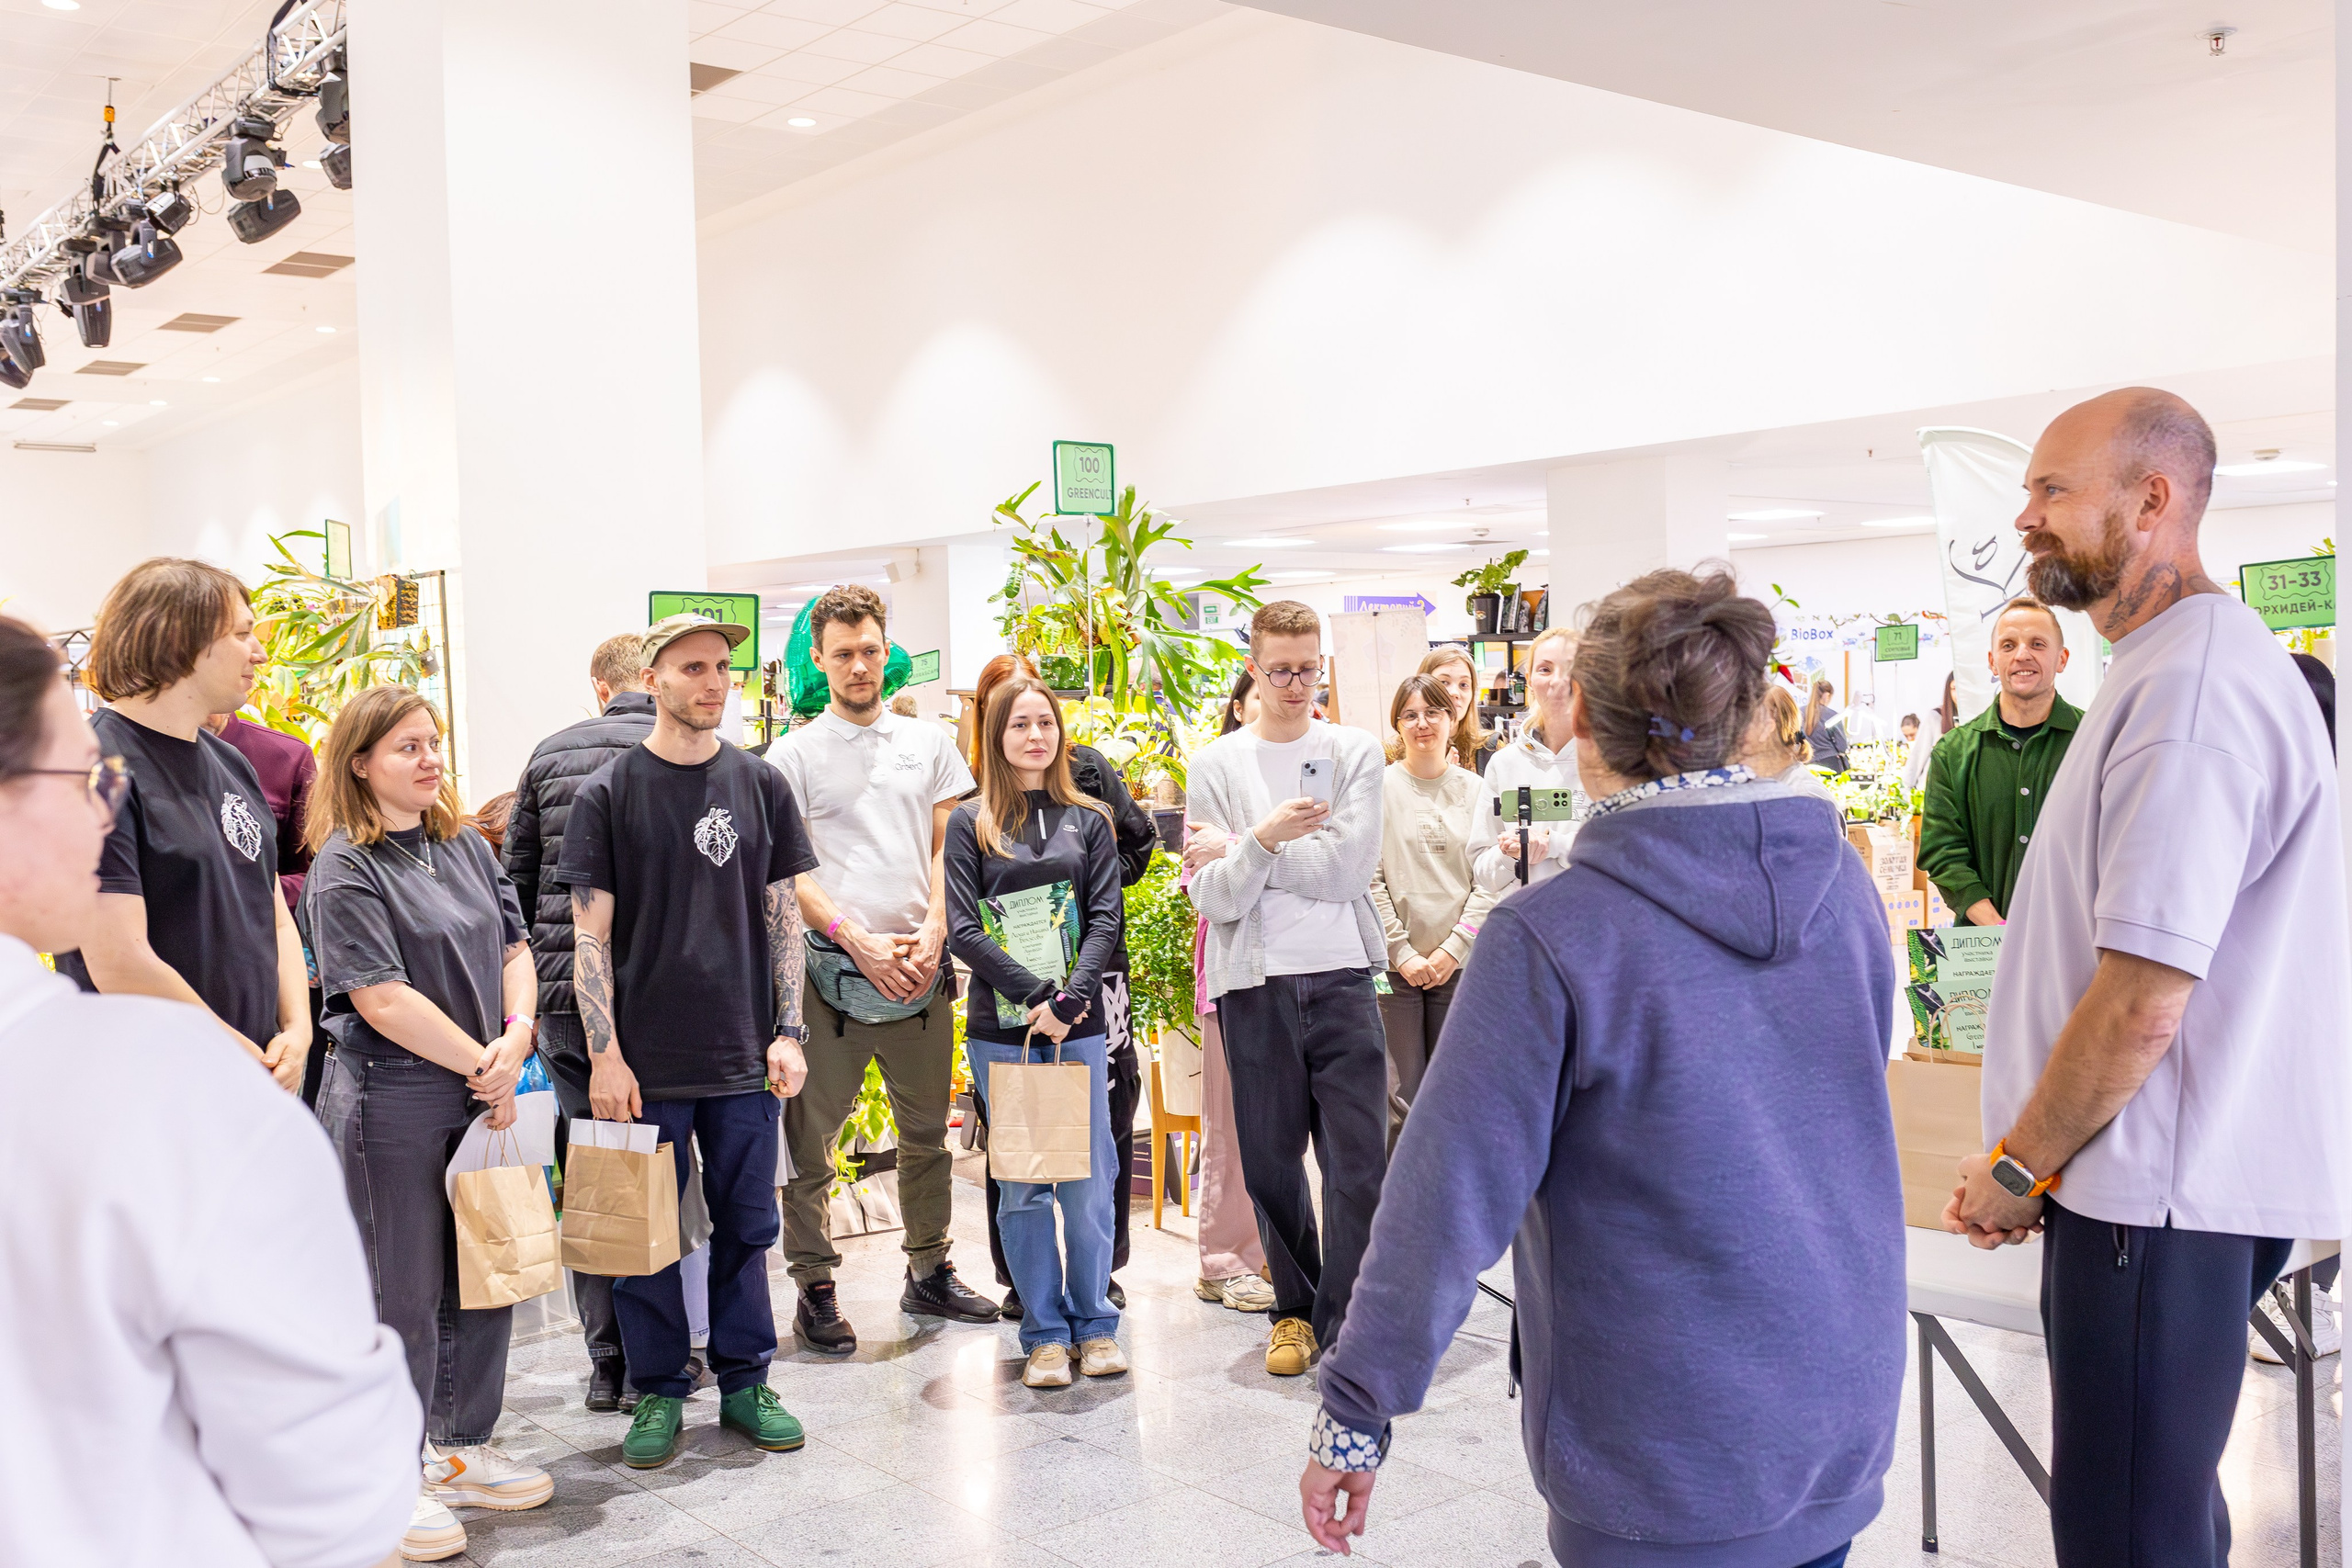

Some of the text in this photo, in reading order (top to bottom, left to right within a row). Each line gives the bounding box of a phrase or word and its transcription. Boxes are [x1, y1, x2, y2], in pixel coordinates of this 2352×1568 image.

[1080, 457, 1100, 473] 100
[2267, 570, 2322, 591] 31-33
[2254, 599, 2335, 615] ОРХИДЕЙ-К
[1791, 627, 1833, 640] BioBox
[1894, 632, 1902, 640] 71
[1010, 896, 1044, 909] ДИПЛОМ
[1951, 936, 2002, 949] ДИПЛОМ
